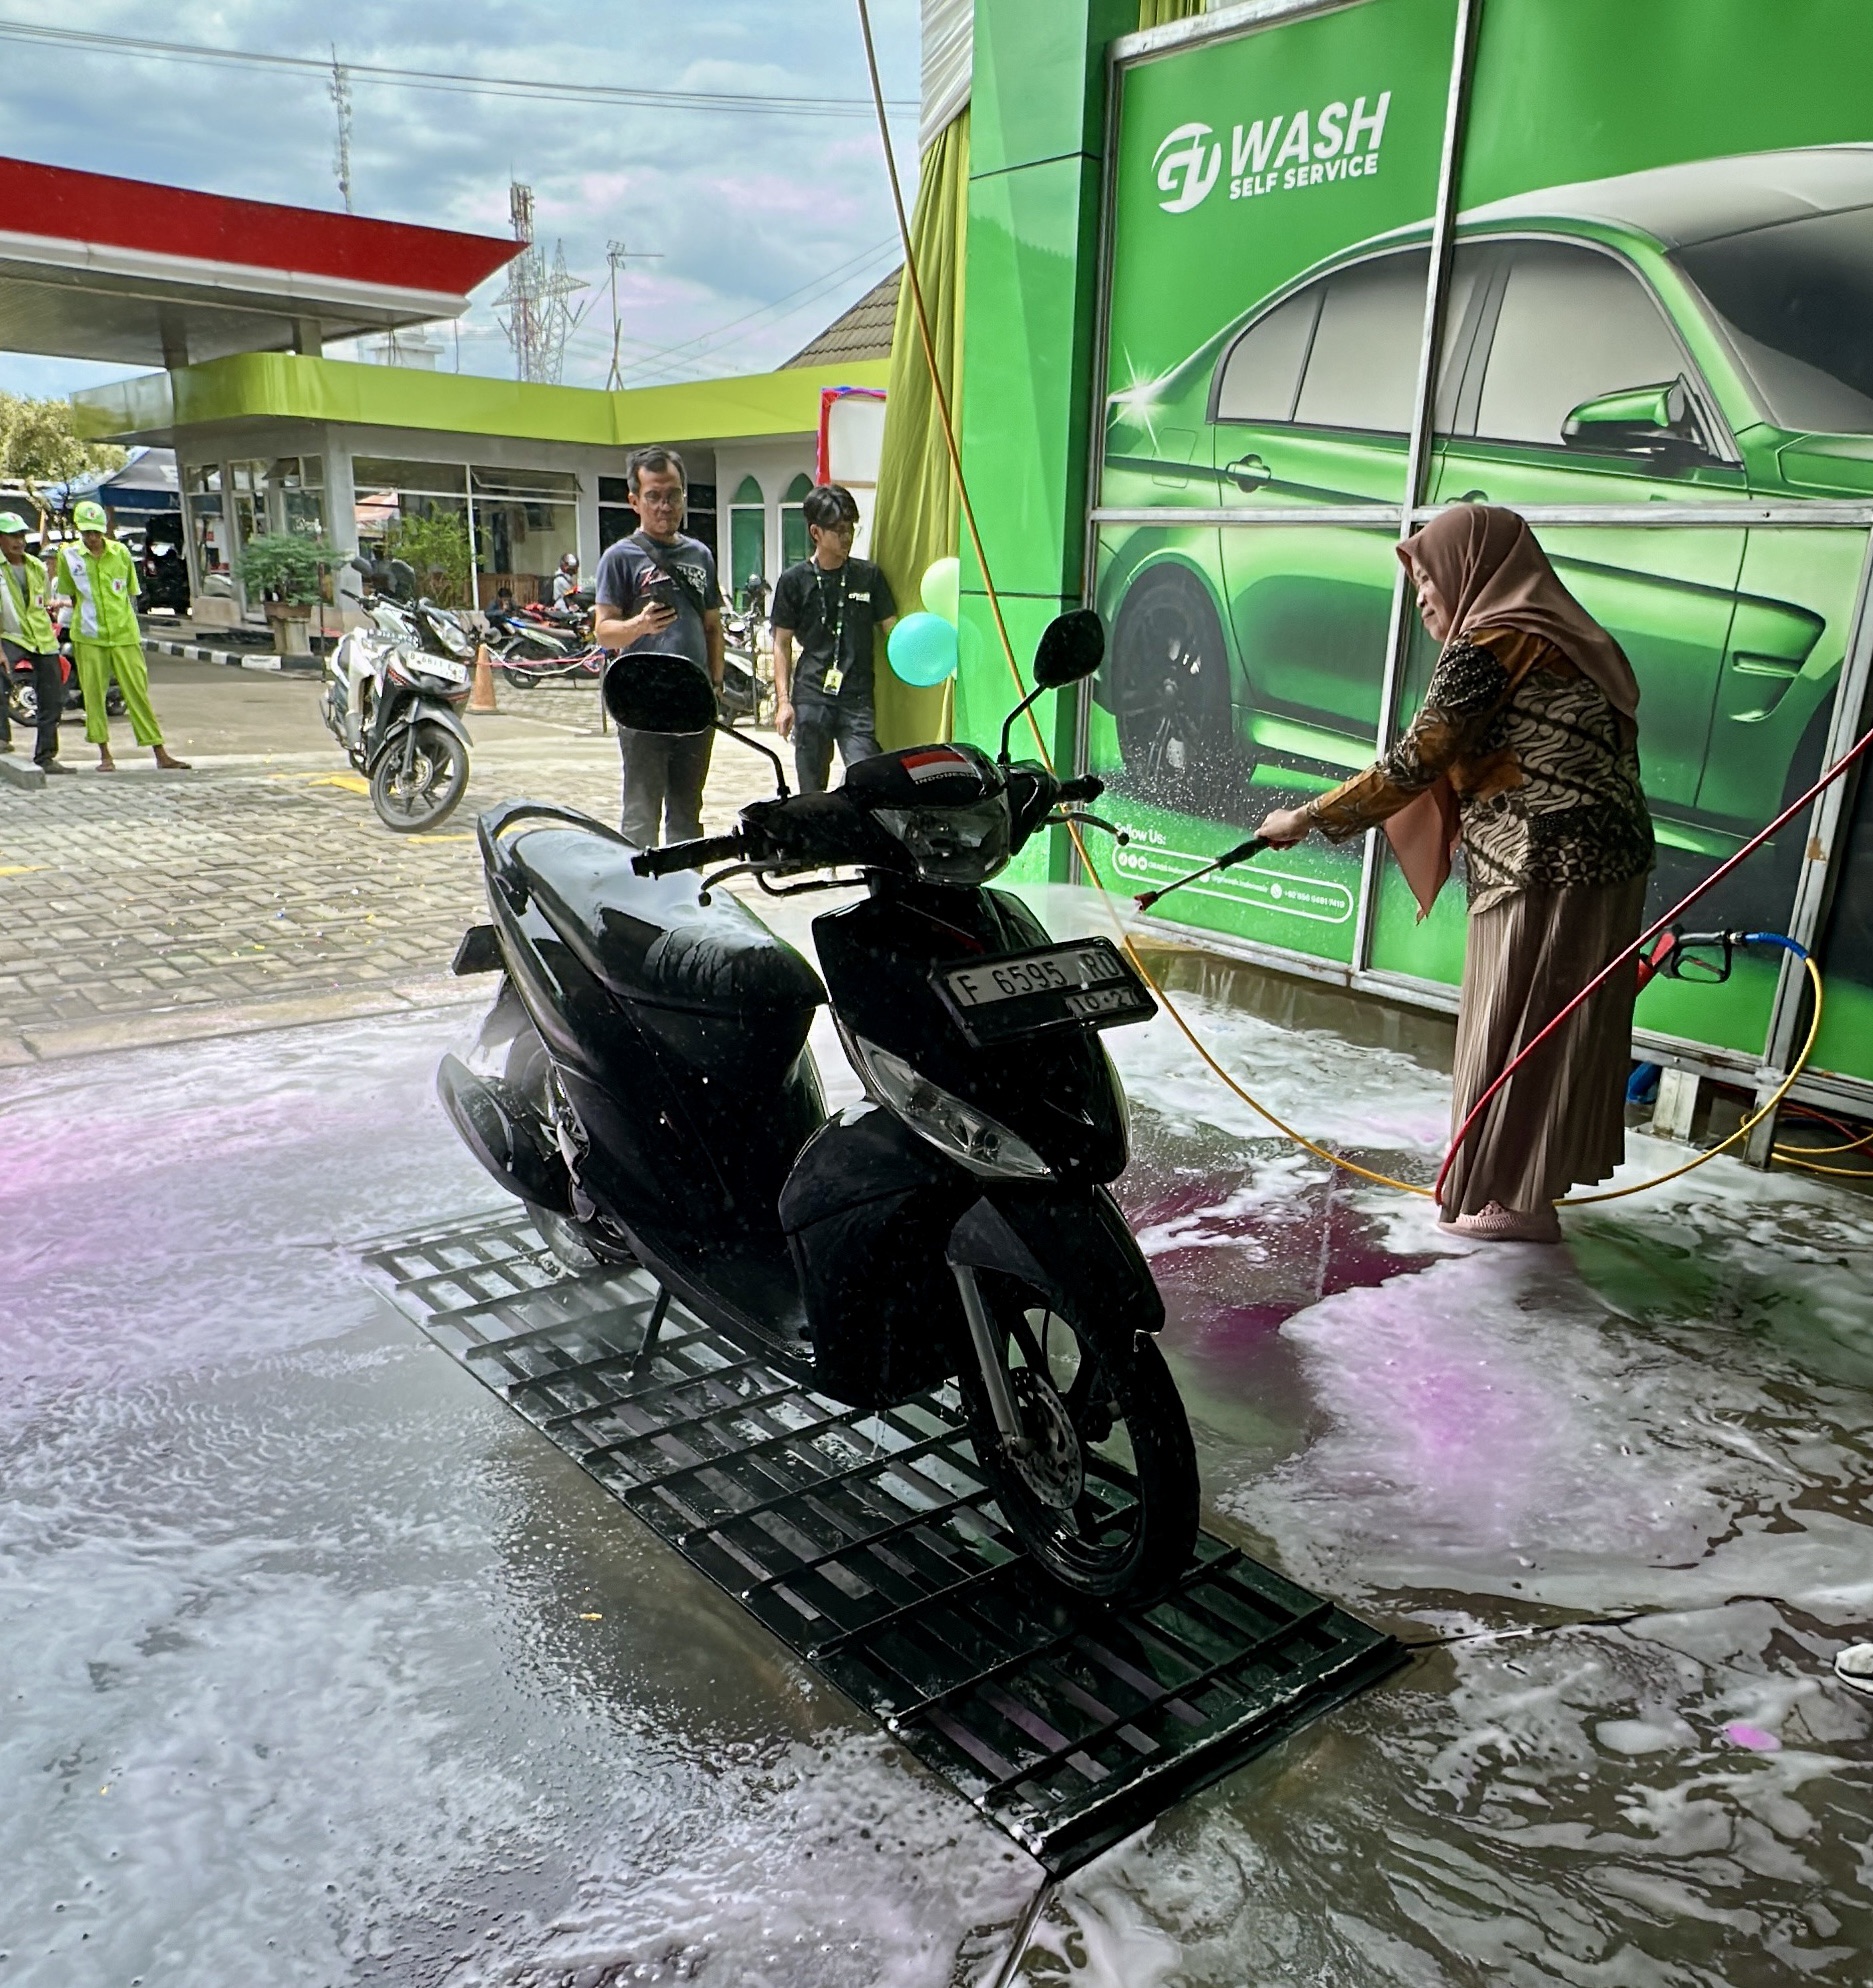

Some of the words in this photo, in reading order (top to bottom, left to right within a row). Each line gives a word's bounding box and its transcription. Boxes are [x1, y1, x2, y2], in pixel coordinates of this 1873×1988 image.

[1231, 91, 1391, 177] WASH
[1229, 172, 1278, 200] SELF
[1283, 153, 1379, 189] SERVICE
[915, 771, 978, 785] INDONESIA
[1148, 828, 1167, 846] Us:
[957, 975, 978, 1003] F
[992, 961, 1068, 995] 6595
